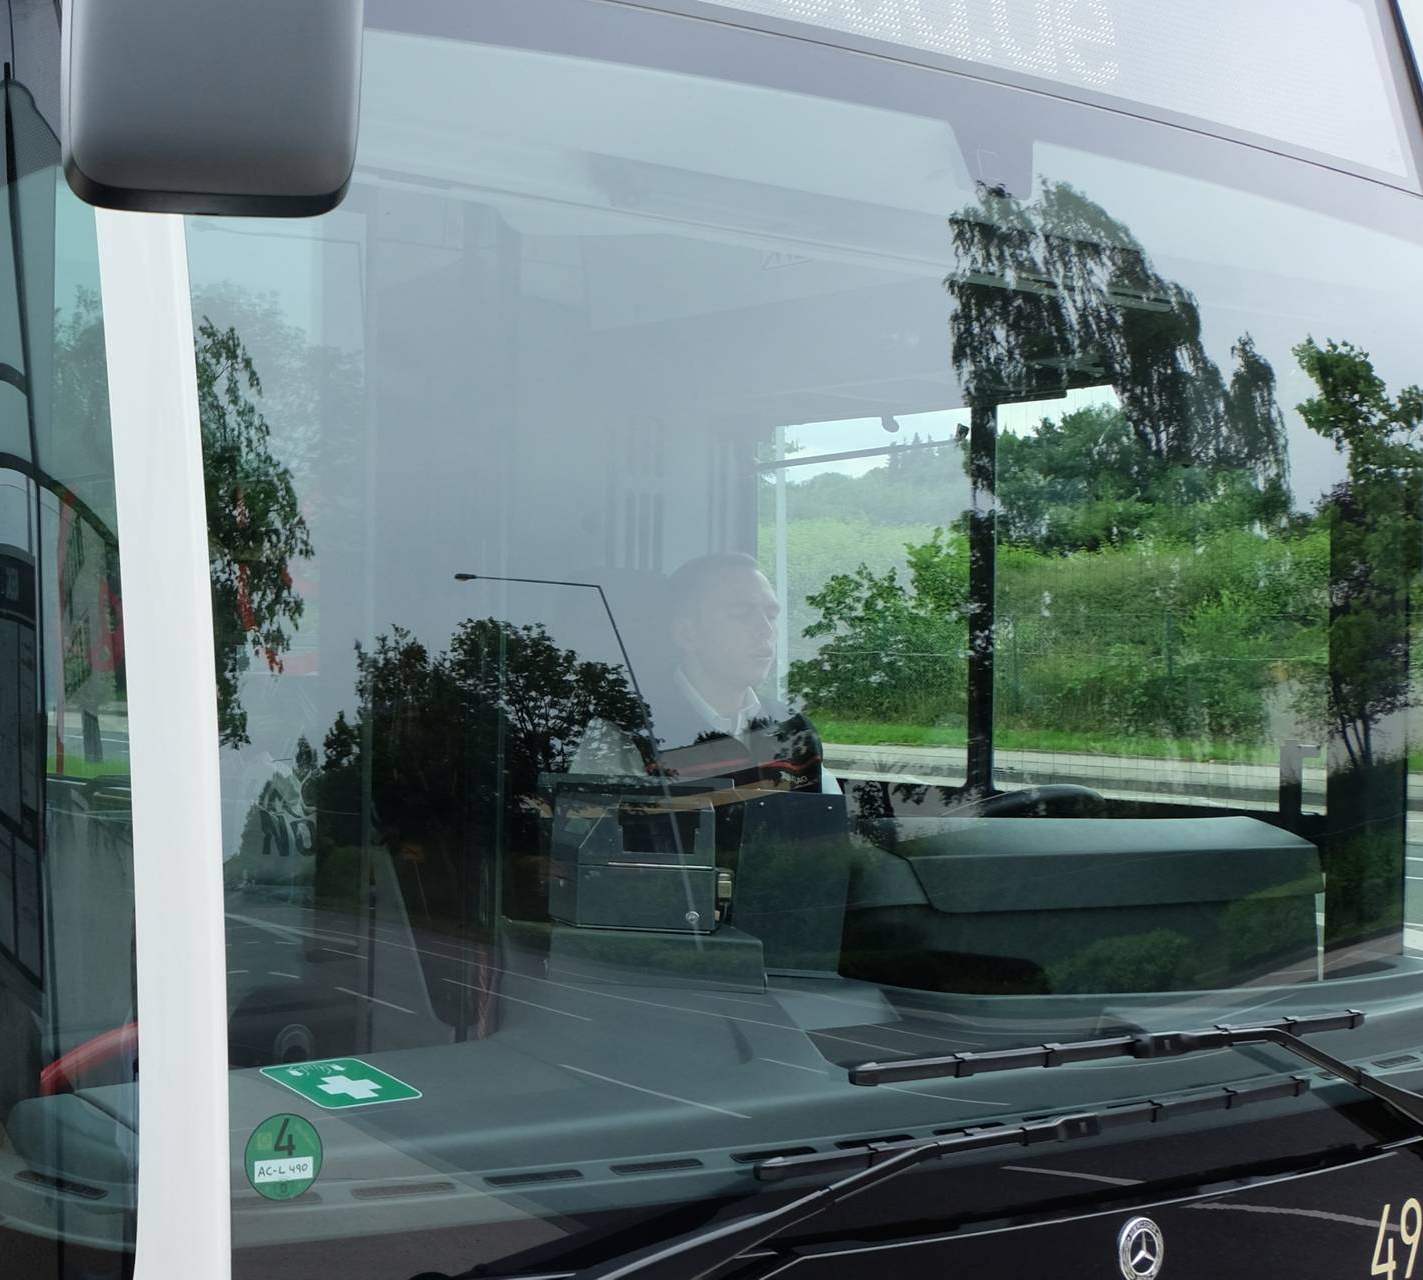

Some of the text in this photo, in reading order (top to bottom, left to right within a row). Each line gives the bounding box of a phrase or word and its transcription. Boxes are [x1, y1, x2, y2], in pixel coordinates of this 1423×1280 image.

[274, 1118, 296, 1156] 4
[258, 1163, 308, 1177] AC-L 490
